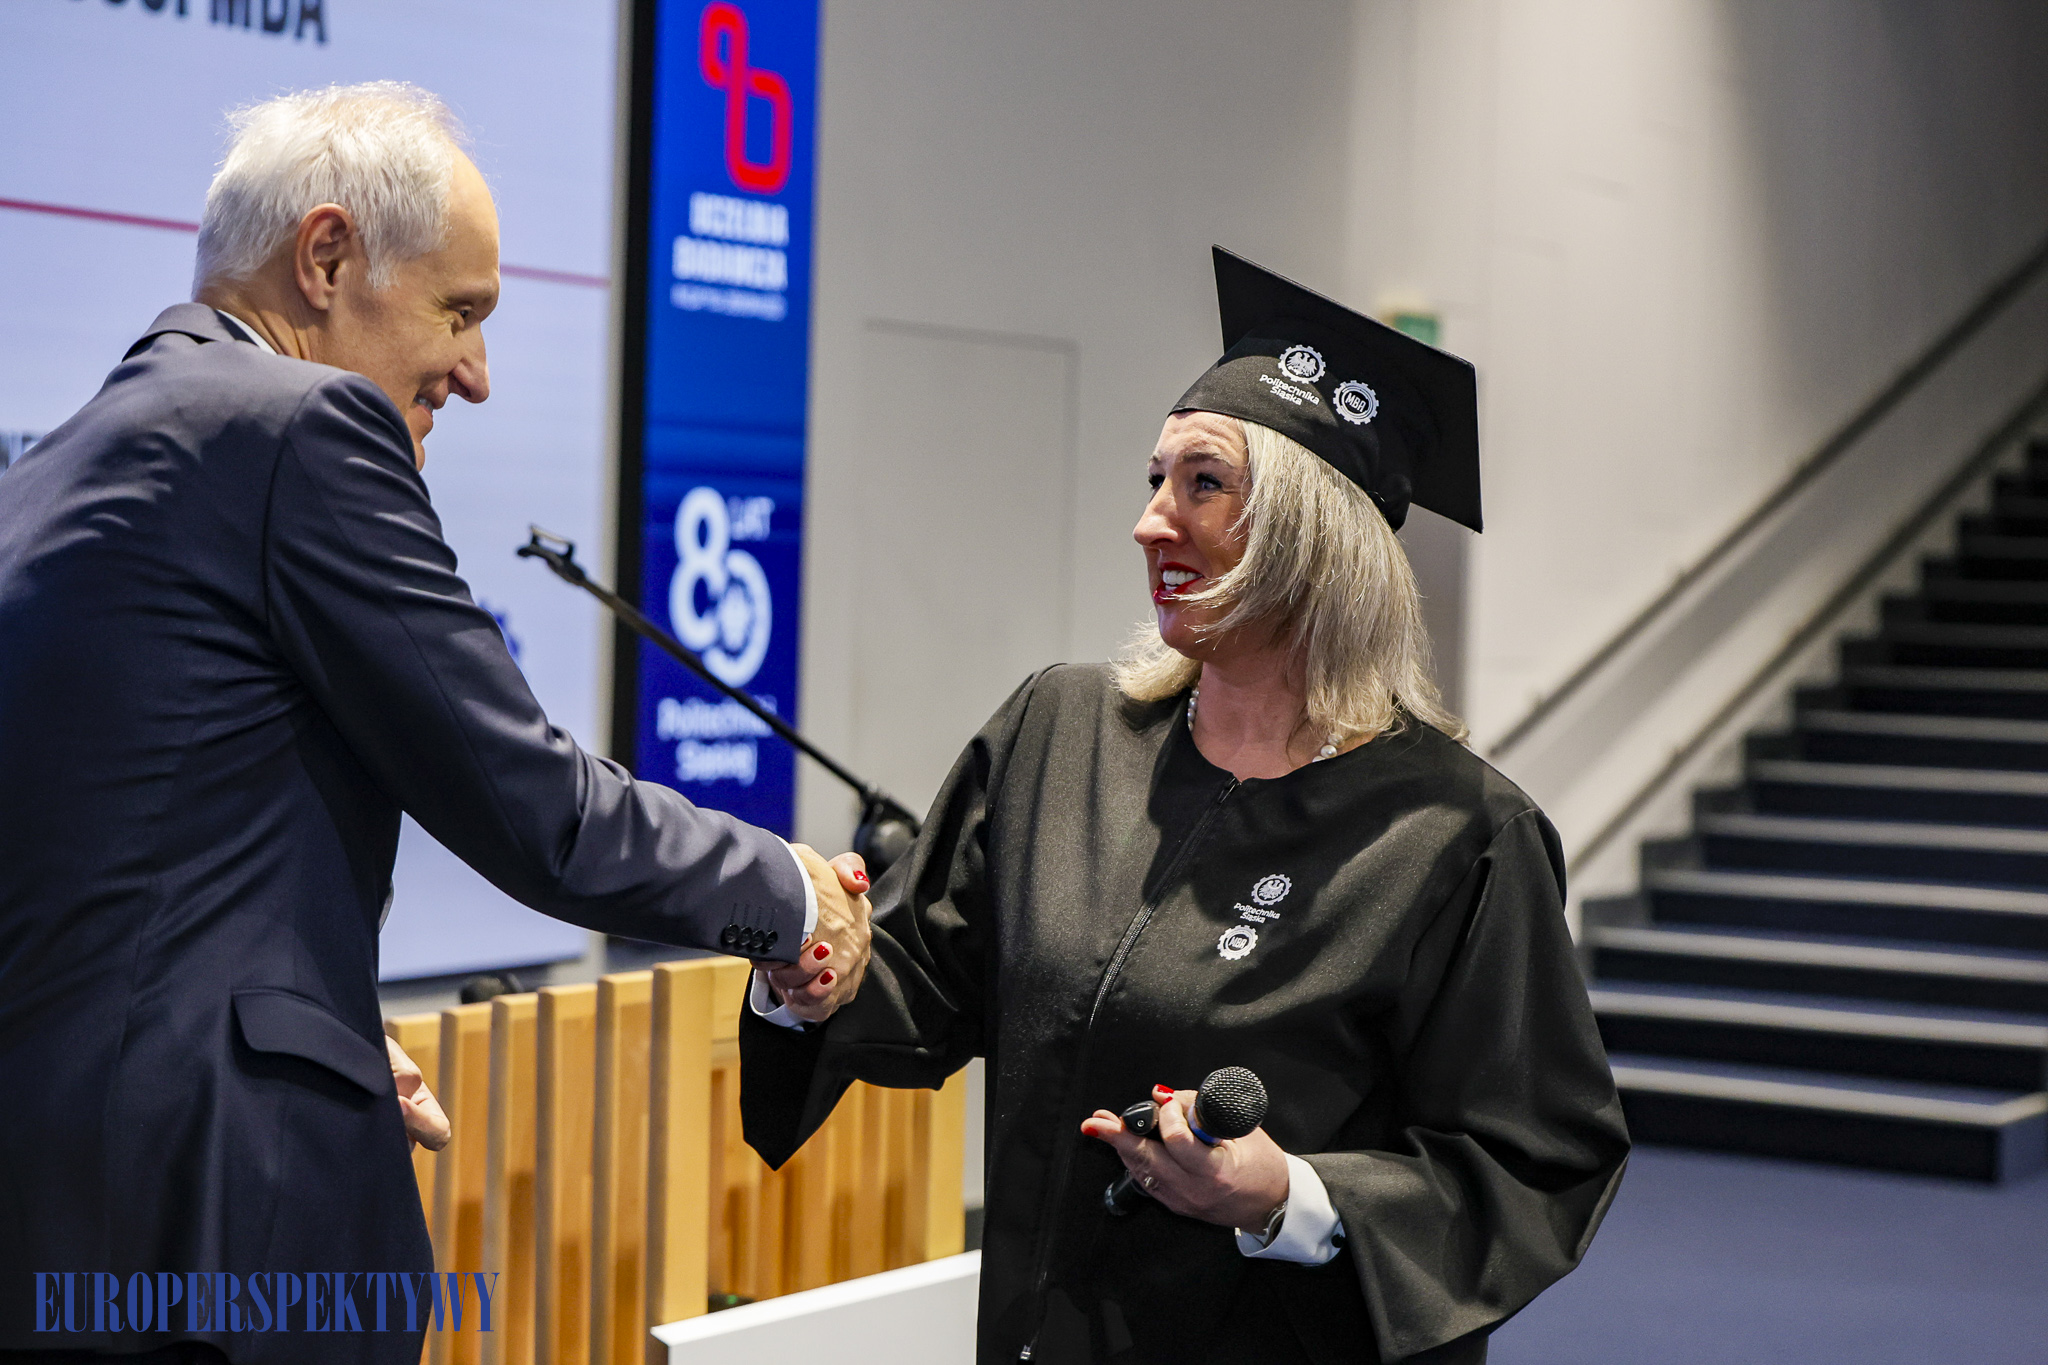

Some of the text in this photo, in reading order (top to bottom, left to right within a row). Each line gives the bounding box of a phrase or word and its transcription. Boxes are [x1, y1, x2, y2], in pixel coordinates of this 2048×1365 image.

[1259, 374, 1320, 405] Politechnika
[1345, 392, 1366, 412] MBA
[1233, 902, 1281, 919] Politechnika
[1228, 936, 1248, 949] MBA
